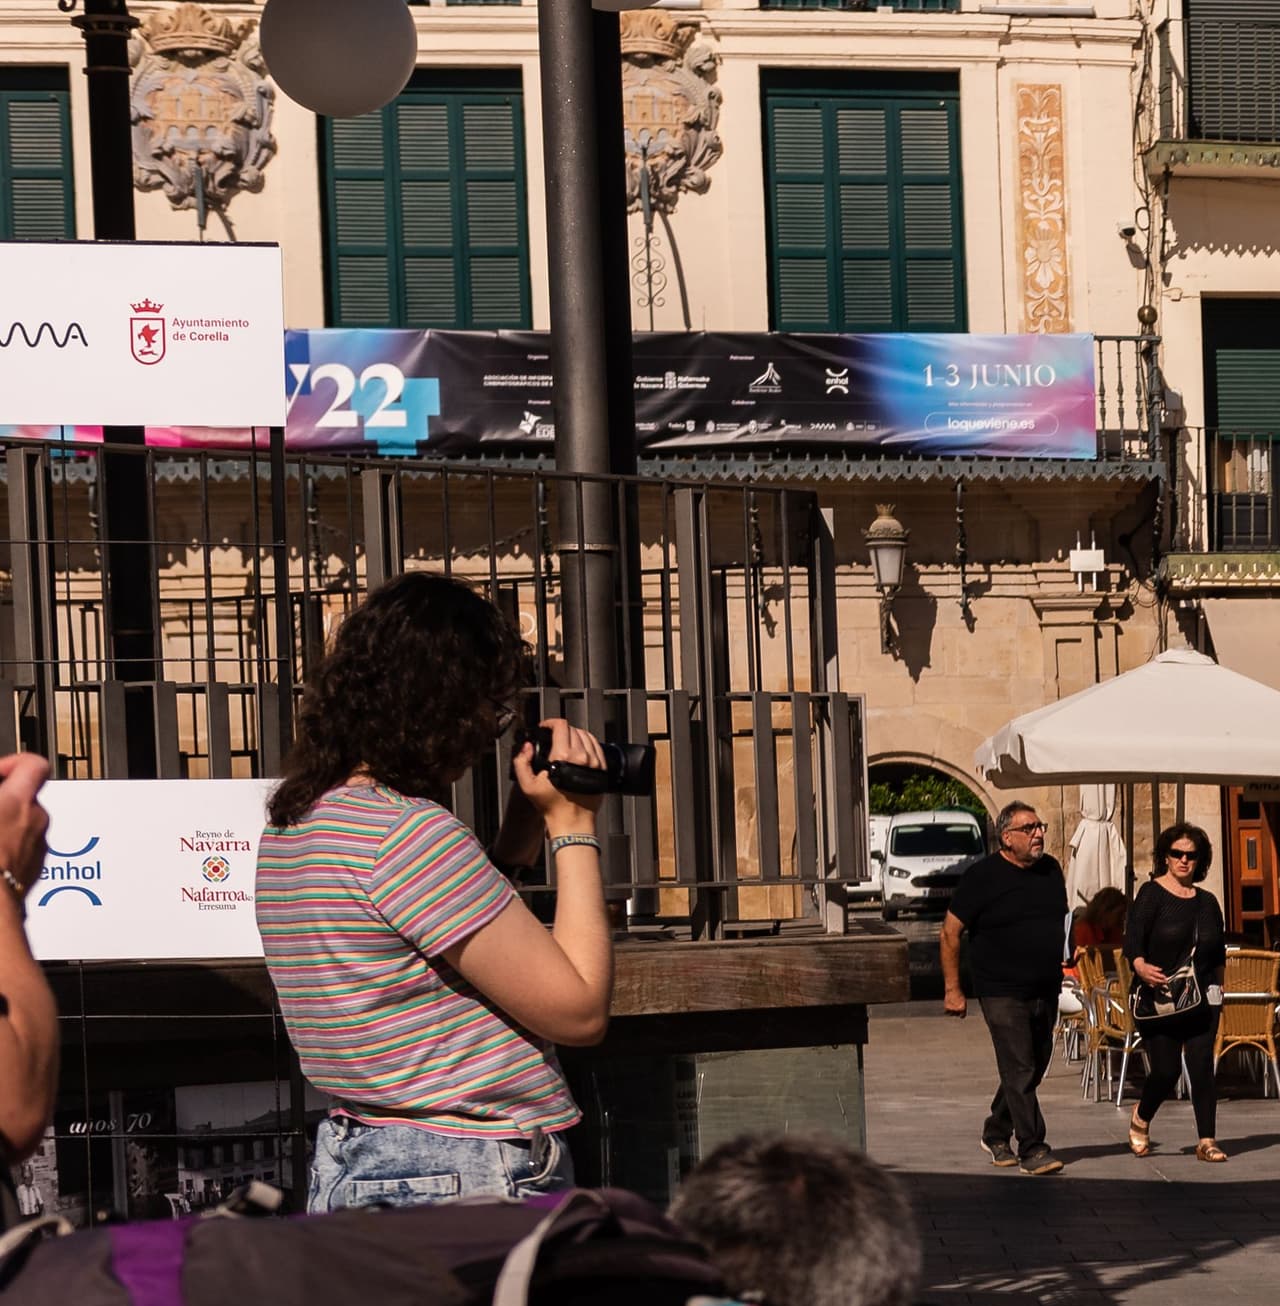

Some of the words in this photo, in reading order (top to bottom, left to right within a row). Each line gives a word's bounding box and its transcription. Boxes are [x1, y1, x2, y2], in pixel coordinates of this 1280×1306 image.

[172, 317, 249, 329] Ayuntamiento
[172, 331, 186, 341] de
[190, 331, 229, 342] Corella
[825, 376, 849, 385] enhol
[923, 363, 960, 388] 1-3
[969, 363, 1056, 391] JUNIO
[947, 416, 1035, 433] loqueviene.es
[195, 830, 222, 841] Reyno
[224, 830, 235, 838] de
[180, 838, 251, 852] Navarra
[39, 861, 101, 880] enhol
[181, 888, 254, 903] Nafarroako
[198, 902, 236, 912] Erresuma
[126, 1111, 153, 1133] 70
